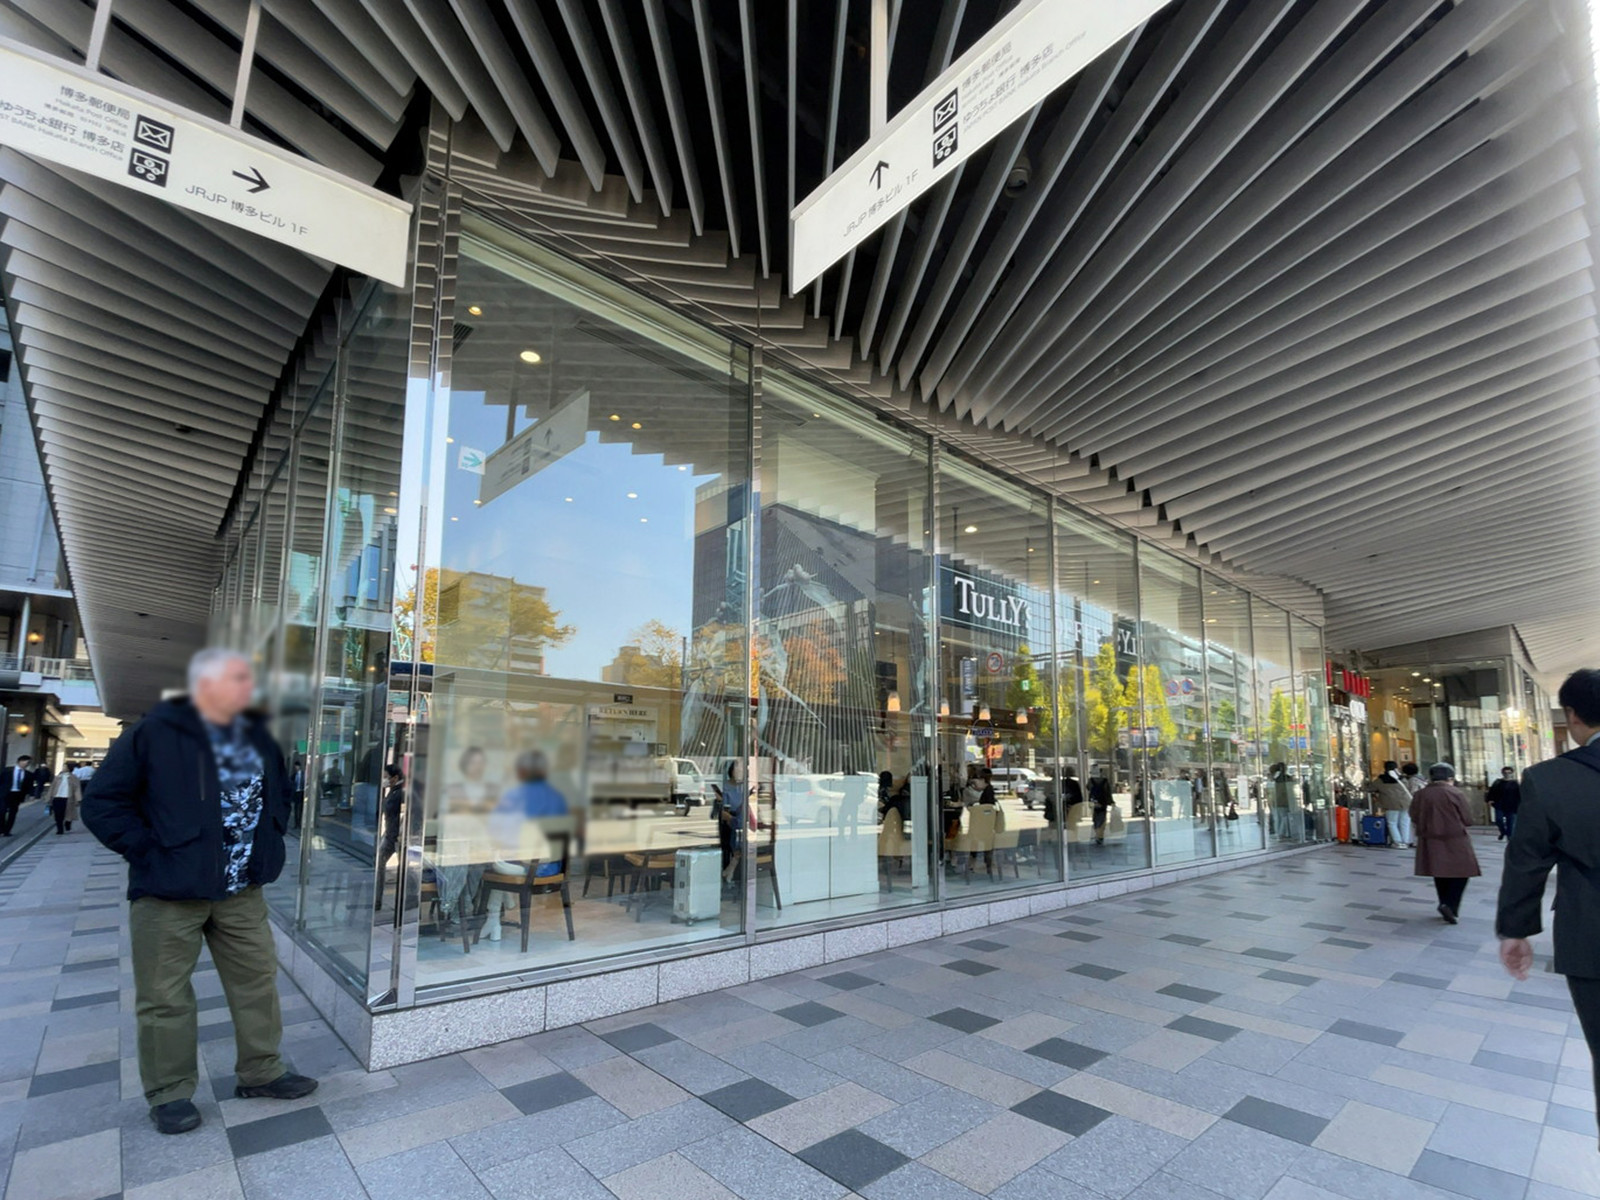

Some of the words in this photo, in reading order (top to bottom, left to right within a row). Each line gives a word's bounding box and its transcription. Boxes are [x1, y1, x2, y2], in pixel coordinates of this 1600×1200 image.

[60, 85, 131, 121] 博多郵便局
[86, 108, 103, 119] Post
[104, 116, 128, 129] Office
[82, 129, 125, 153] 博多店
[185, 185, 228, 204] JRJP
[231, 200, 286, 228] 博多ビル
[291, 222, 309, 236] 1F
